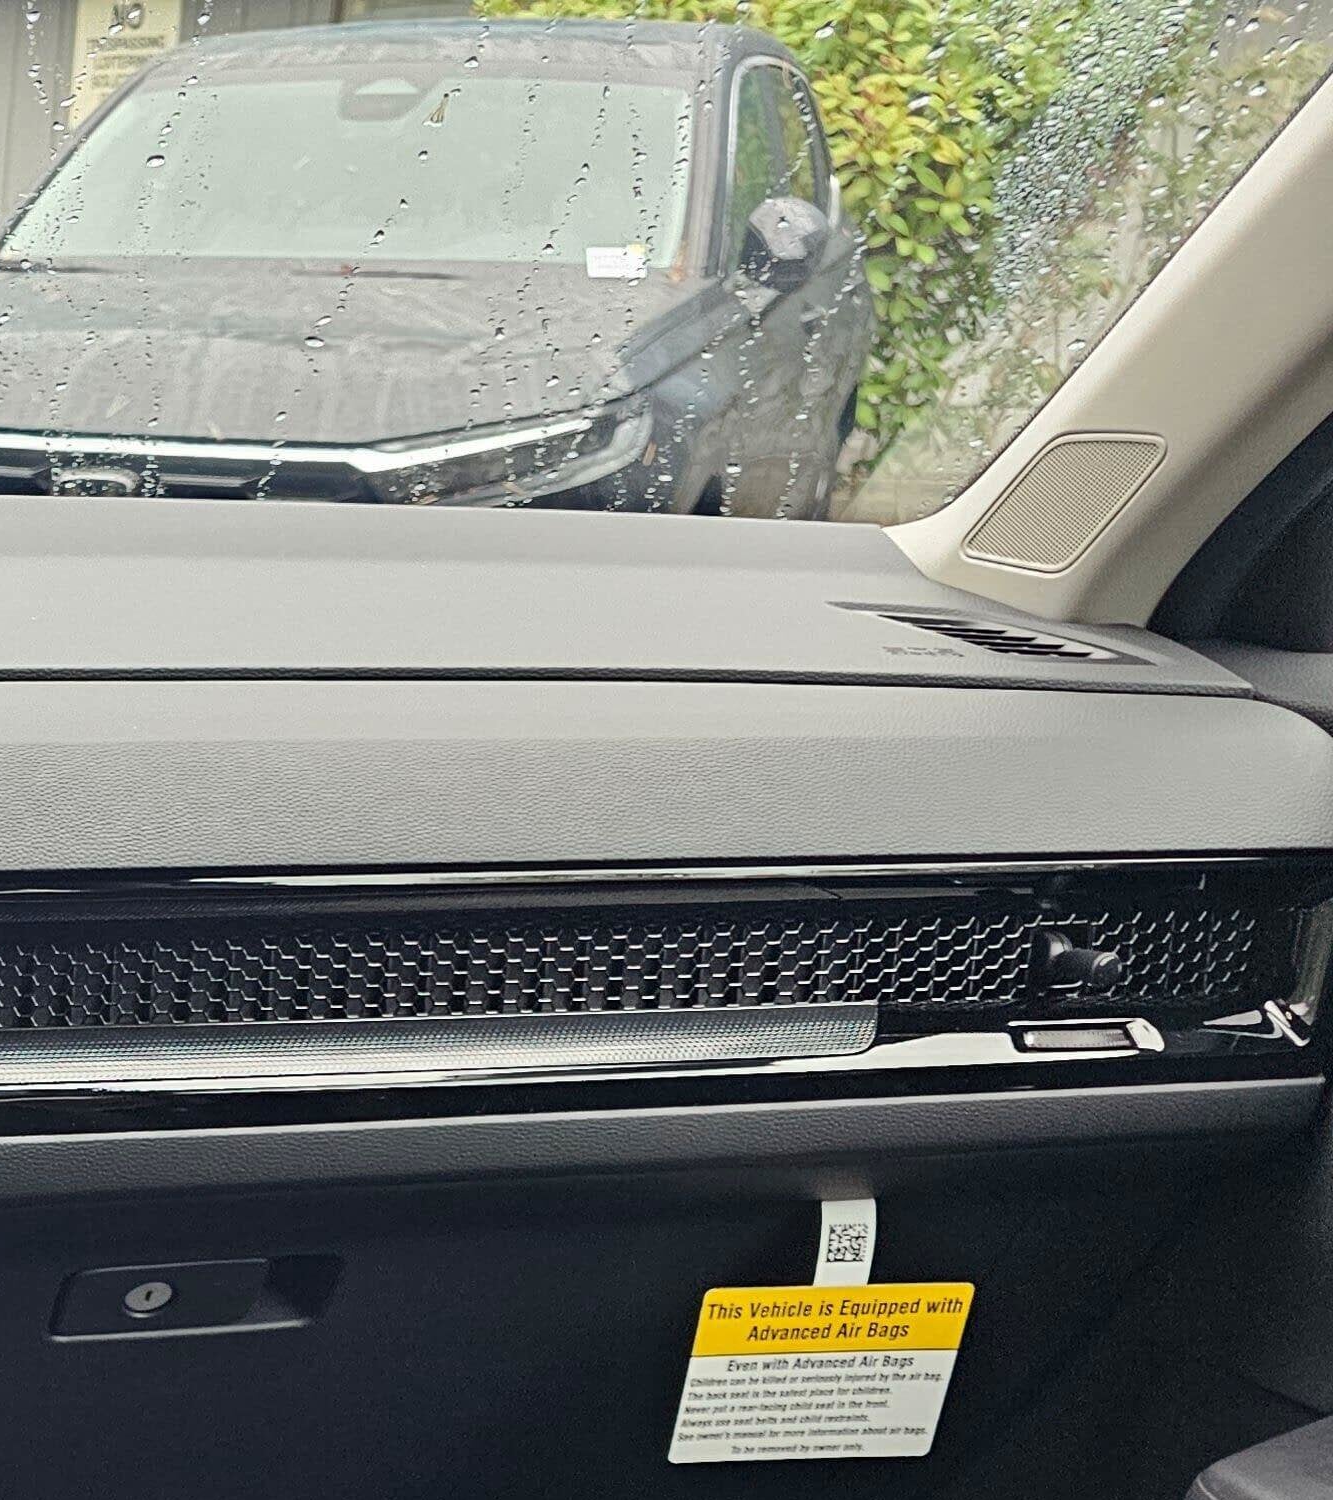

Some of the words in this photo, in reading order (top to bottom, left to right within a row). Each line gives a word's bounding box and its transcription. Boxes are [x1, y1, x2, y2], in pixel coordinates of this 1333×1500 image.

[708, 1303, 743, 1320] This
[749, 1300, 813, 1318] Vehicle
[819, 1300, 833, 1316] is
[839, 1298, 922, 1318] Equipped
[926, 1297, 963, 1314] with
[747, 1323, 833, 1341] Advanced
[836, 1322, 862, 1339] Air
[866, 1321, 910, 1341] Bags
[727, 1360, 758, 1372] Even
[762, 1358, 789, 1370] with
[792, 1356, 856, 1370] Advanced
[859, 1355, 879, 1368] Air
[882, 1355, 915, 1370] Bags
